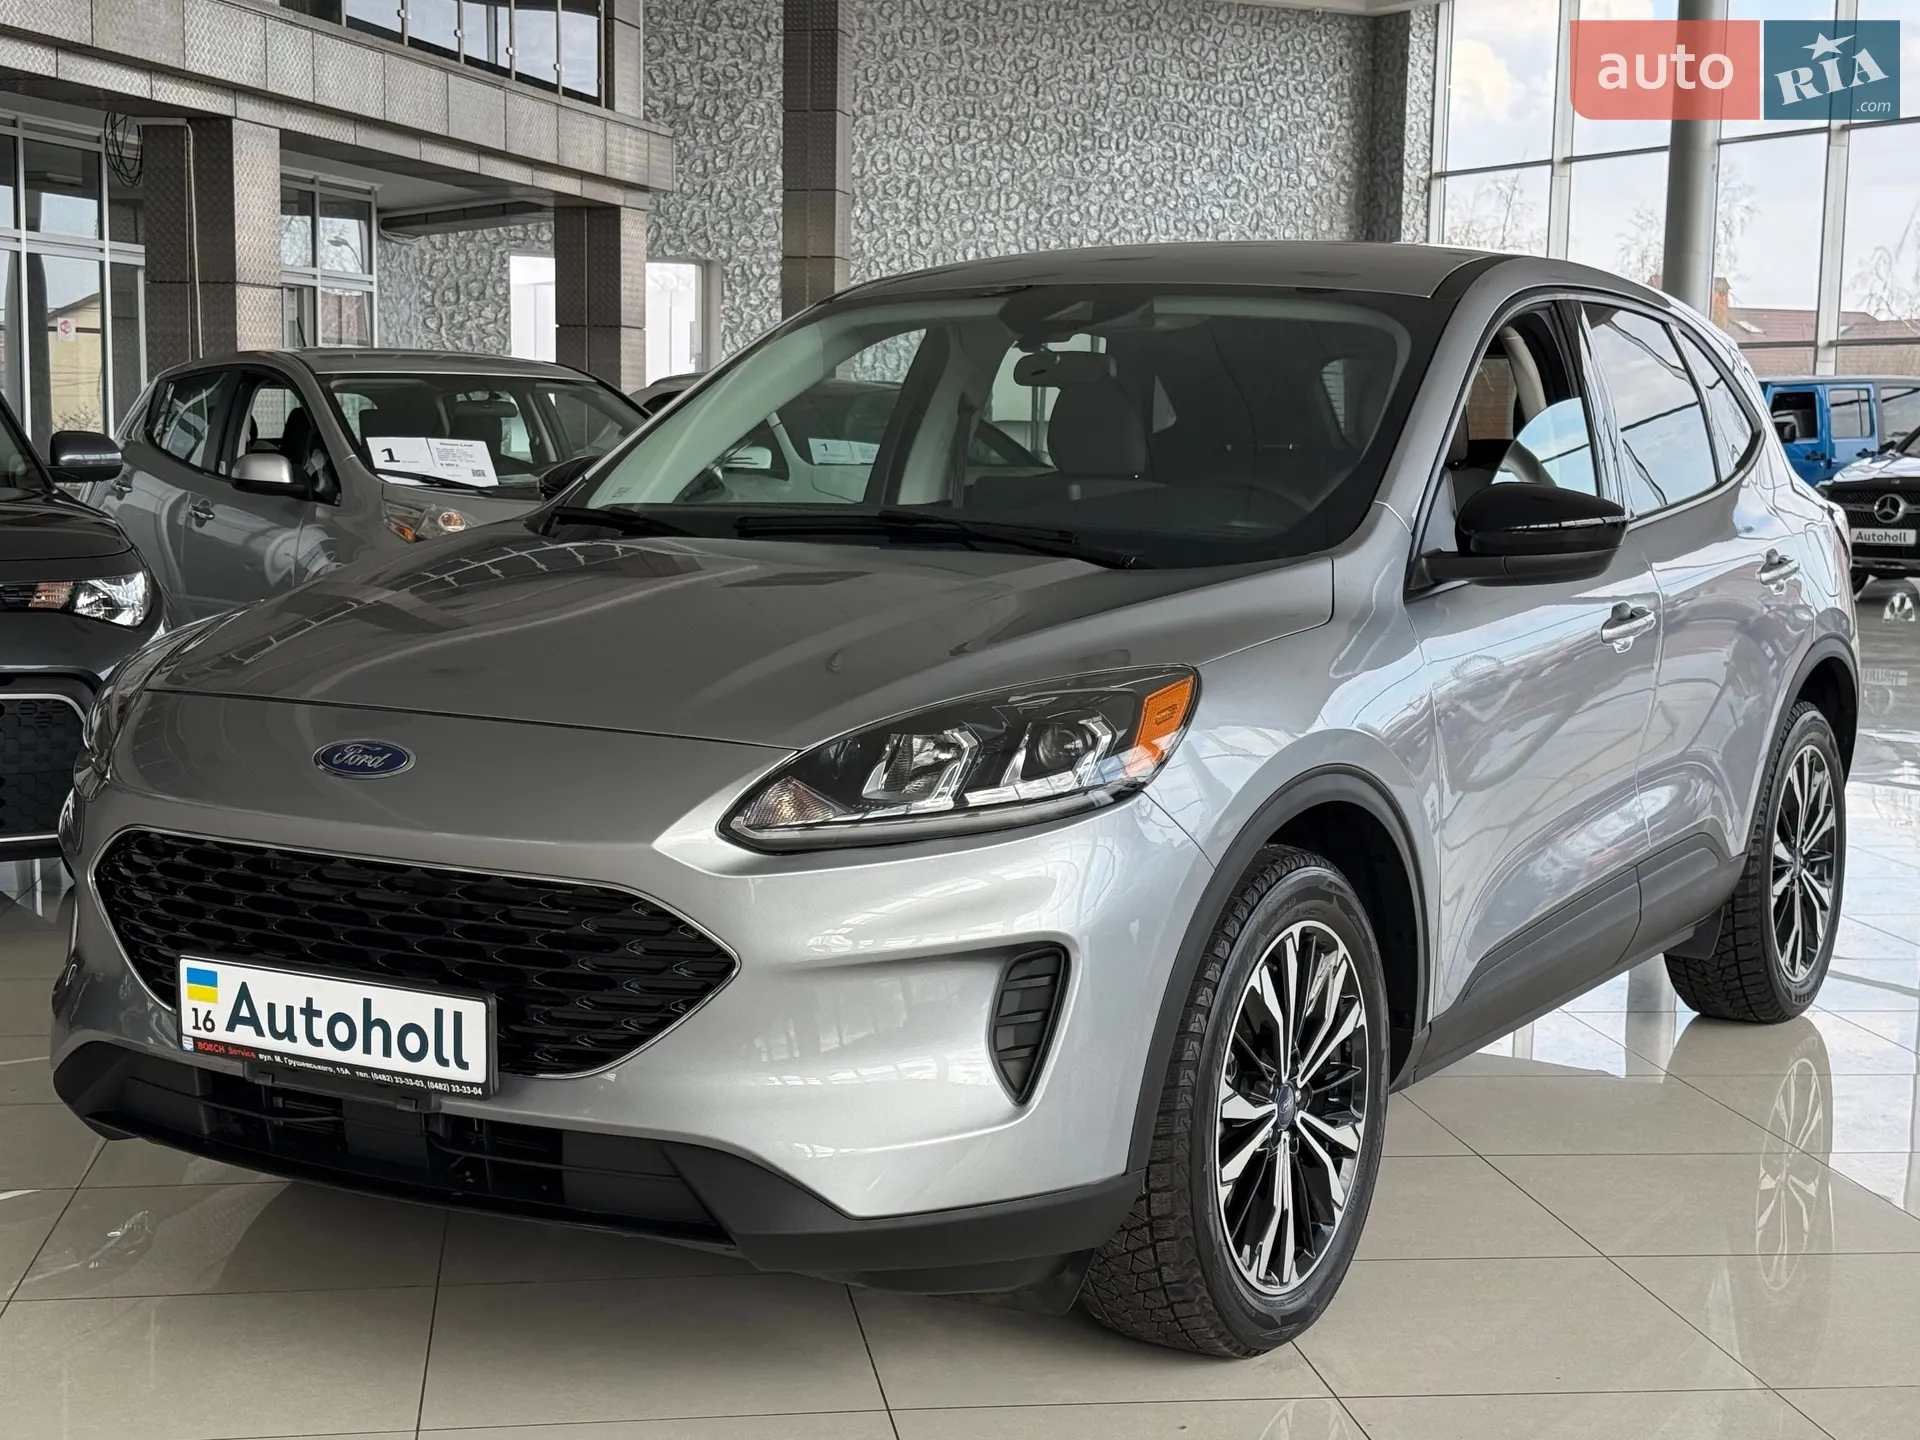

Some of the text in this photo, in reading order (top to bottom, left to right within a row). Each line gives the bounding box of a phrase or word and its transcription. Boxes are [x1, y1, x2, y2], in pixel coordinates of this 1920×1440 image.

[381, 447, 401, 463] 1
[1855, 531, 1907, 543] Autoholl
[332, 743, 392, 769] Ford
[191, 1007, 216, 1034] 16
[225, 981, 470, 1071] Autoholl
[197, 1041, 225, 1054] BOSCH
[228, 1046, 257, 1060] Service
[258, 1053, 273, 1063] вул.
[355, 1070, 371, 1080] тел.
[371, 1071, 394, 1084] (0482)
[394, 1076, 427, 1089] 33-33-03,
[427, 1080, 450, 1093] (0482)
[450, 1084, 483, 1096] 33-33-04
